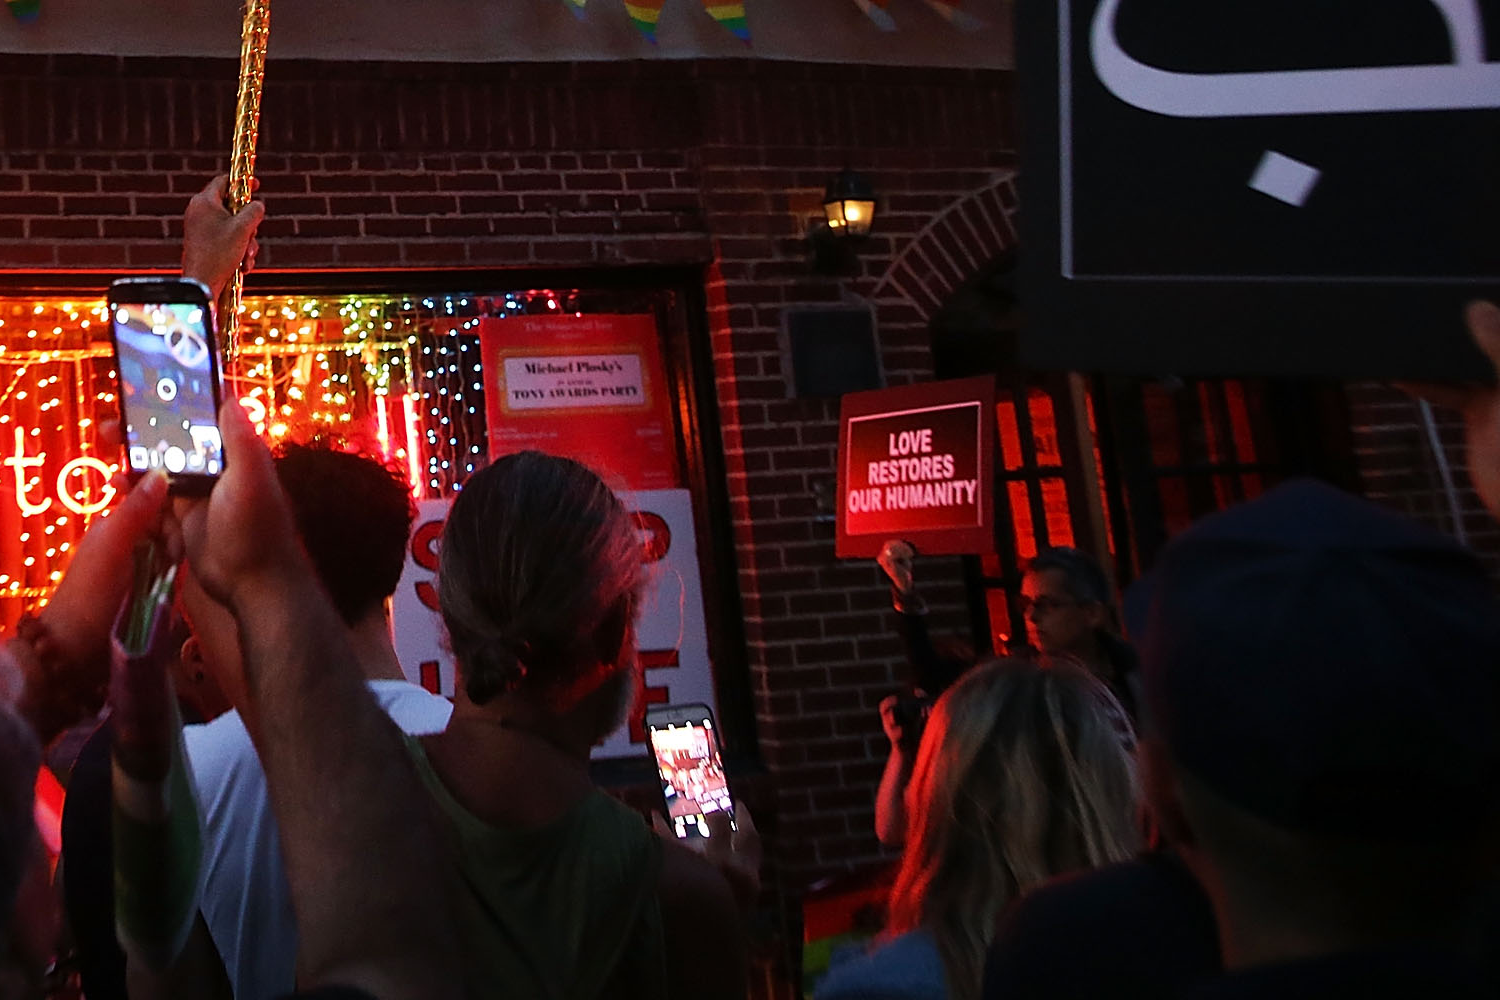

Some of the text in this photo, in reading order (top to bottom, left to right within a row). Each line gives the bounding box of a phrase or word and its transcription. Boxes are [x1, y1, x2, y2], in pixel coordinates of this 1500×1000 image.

[525, 362, 573, 374] Michael
[512, 385, 638, 400] TONY AWARDS PARTY
[889, 428, 933, 456] LOVE
[868, 454, 955, 486] RESTORES
[849, 479, 978, 513] OUR HUMANITY
